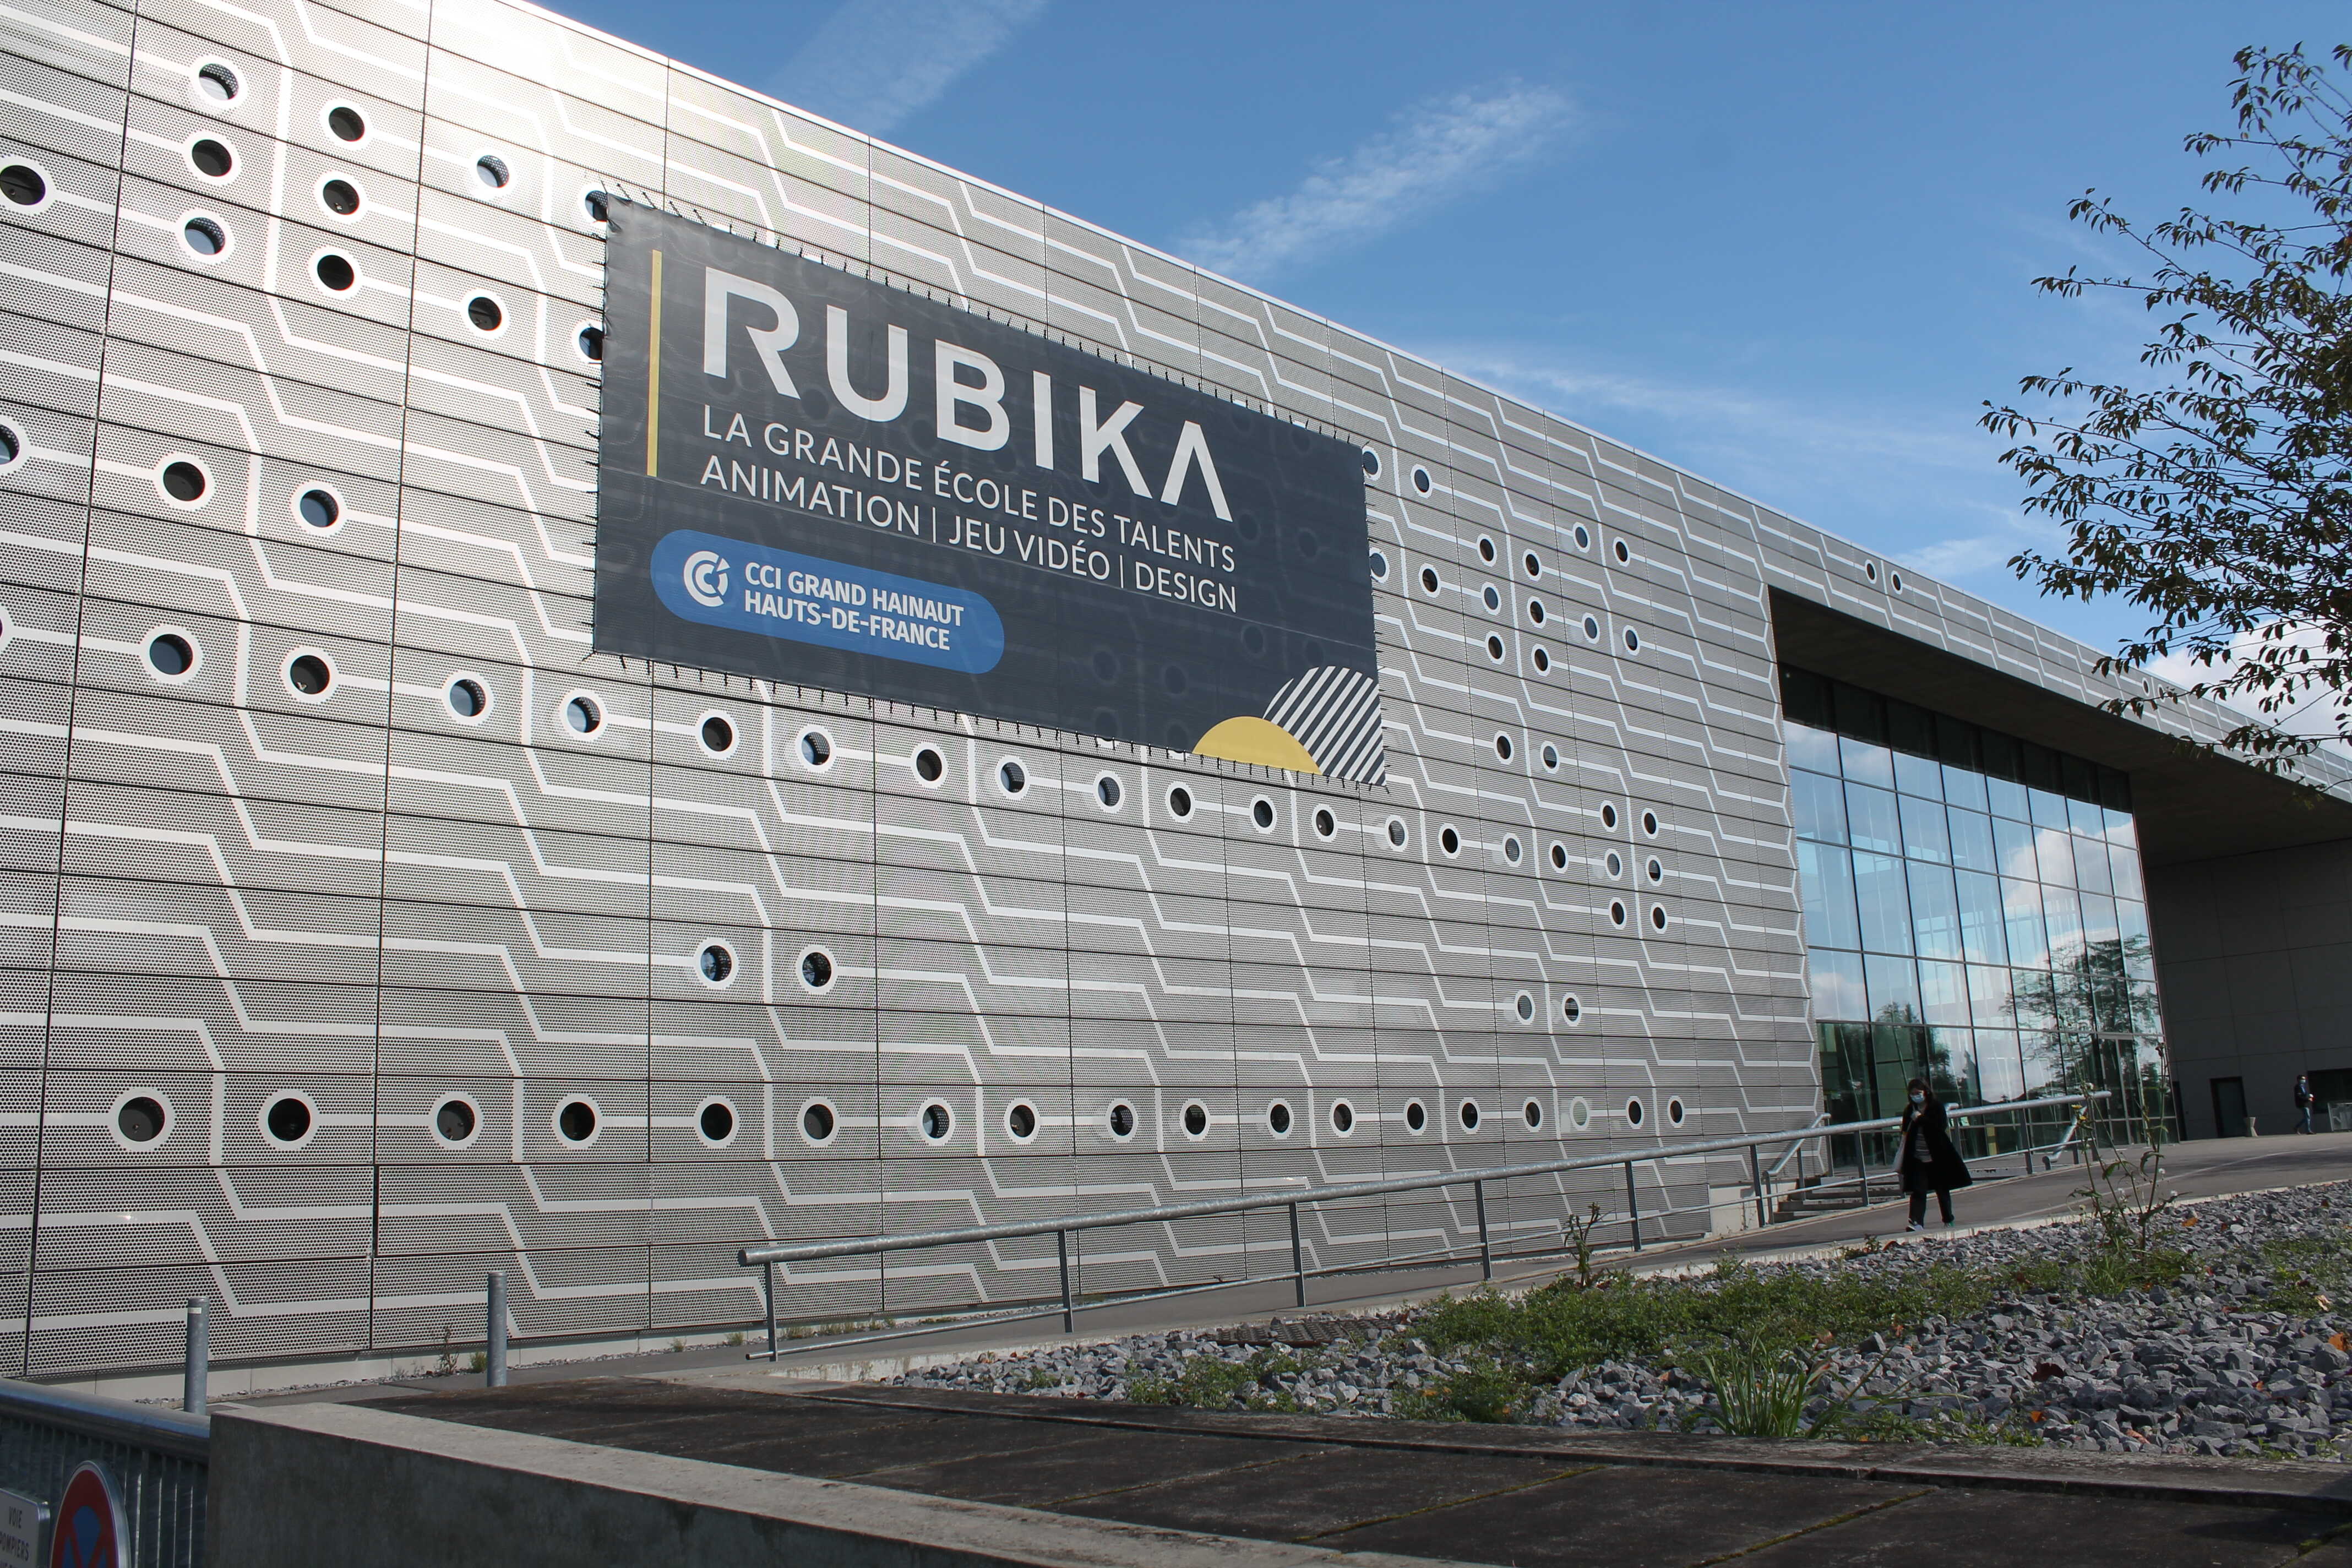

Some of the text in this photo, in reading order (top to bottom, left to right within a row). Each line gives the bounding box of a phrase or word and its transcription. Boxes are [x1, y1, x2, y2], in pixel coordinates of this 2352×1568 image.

[704, 266, 1233, 523] RUBIKA
[700, 454, 919, 536] ANIMATION
[948, 515, 1005, 555] JEU
[1013, 529, 1110, 580] VIDÉO
[1135, 560, 1237, 613] DESIGN
[704, 404, 1235, 573] LA GRANDE ÉCOLE DES TALENTS
[744, 562, 782, 590] CCI
[787, 570, 867, 606] GRAND
[872, 587, 965, 627] HAINAUT
[744, 589, 951, 651] HAUTS-DE-FRANCE
[9, 1506, 22, 1529] VOIE
